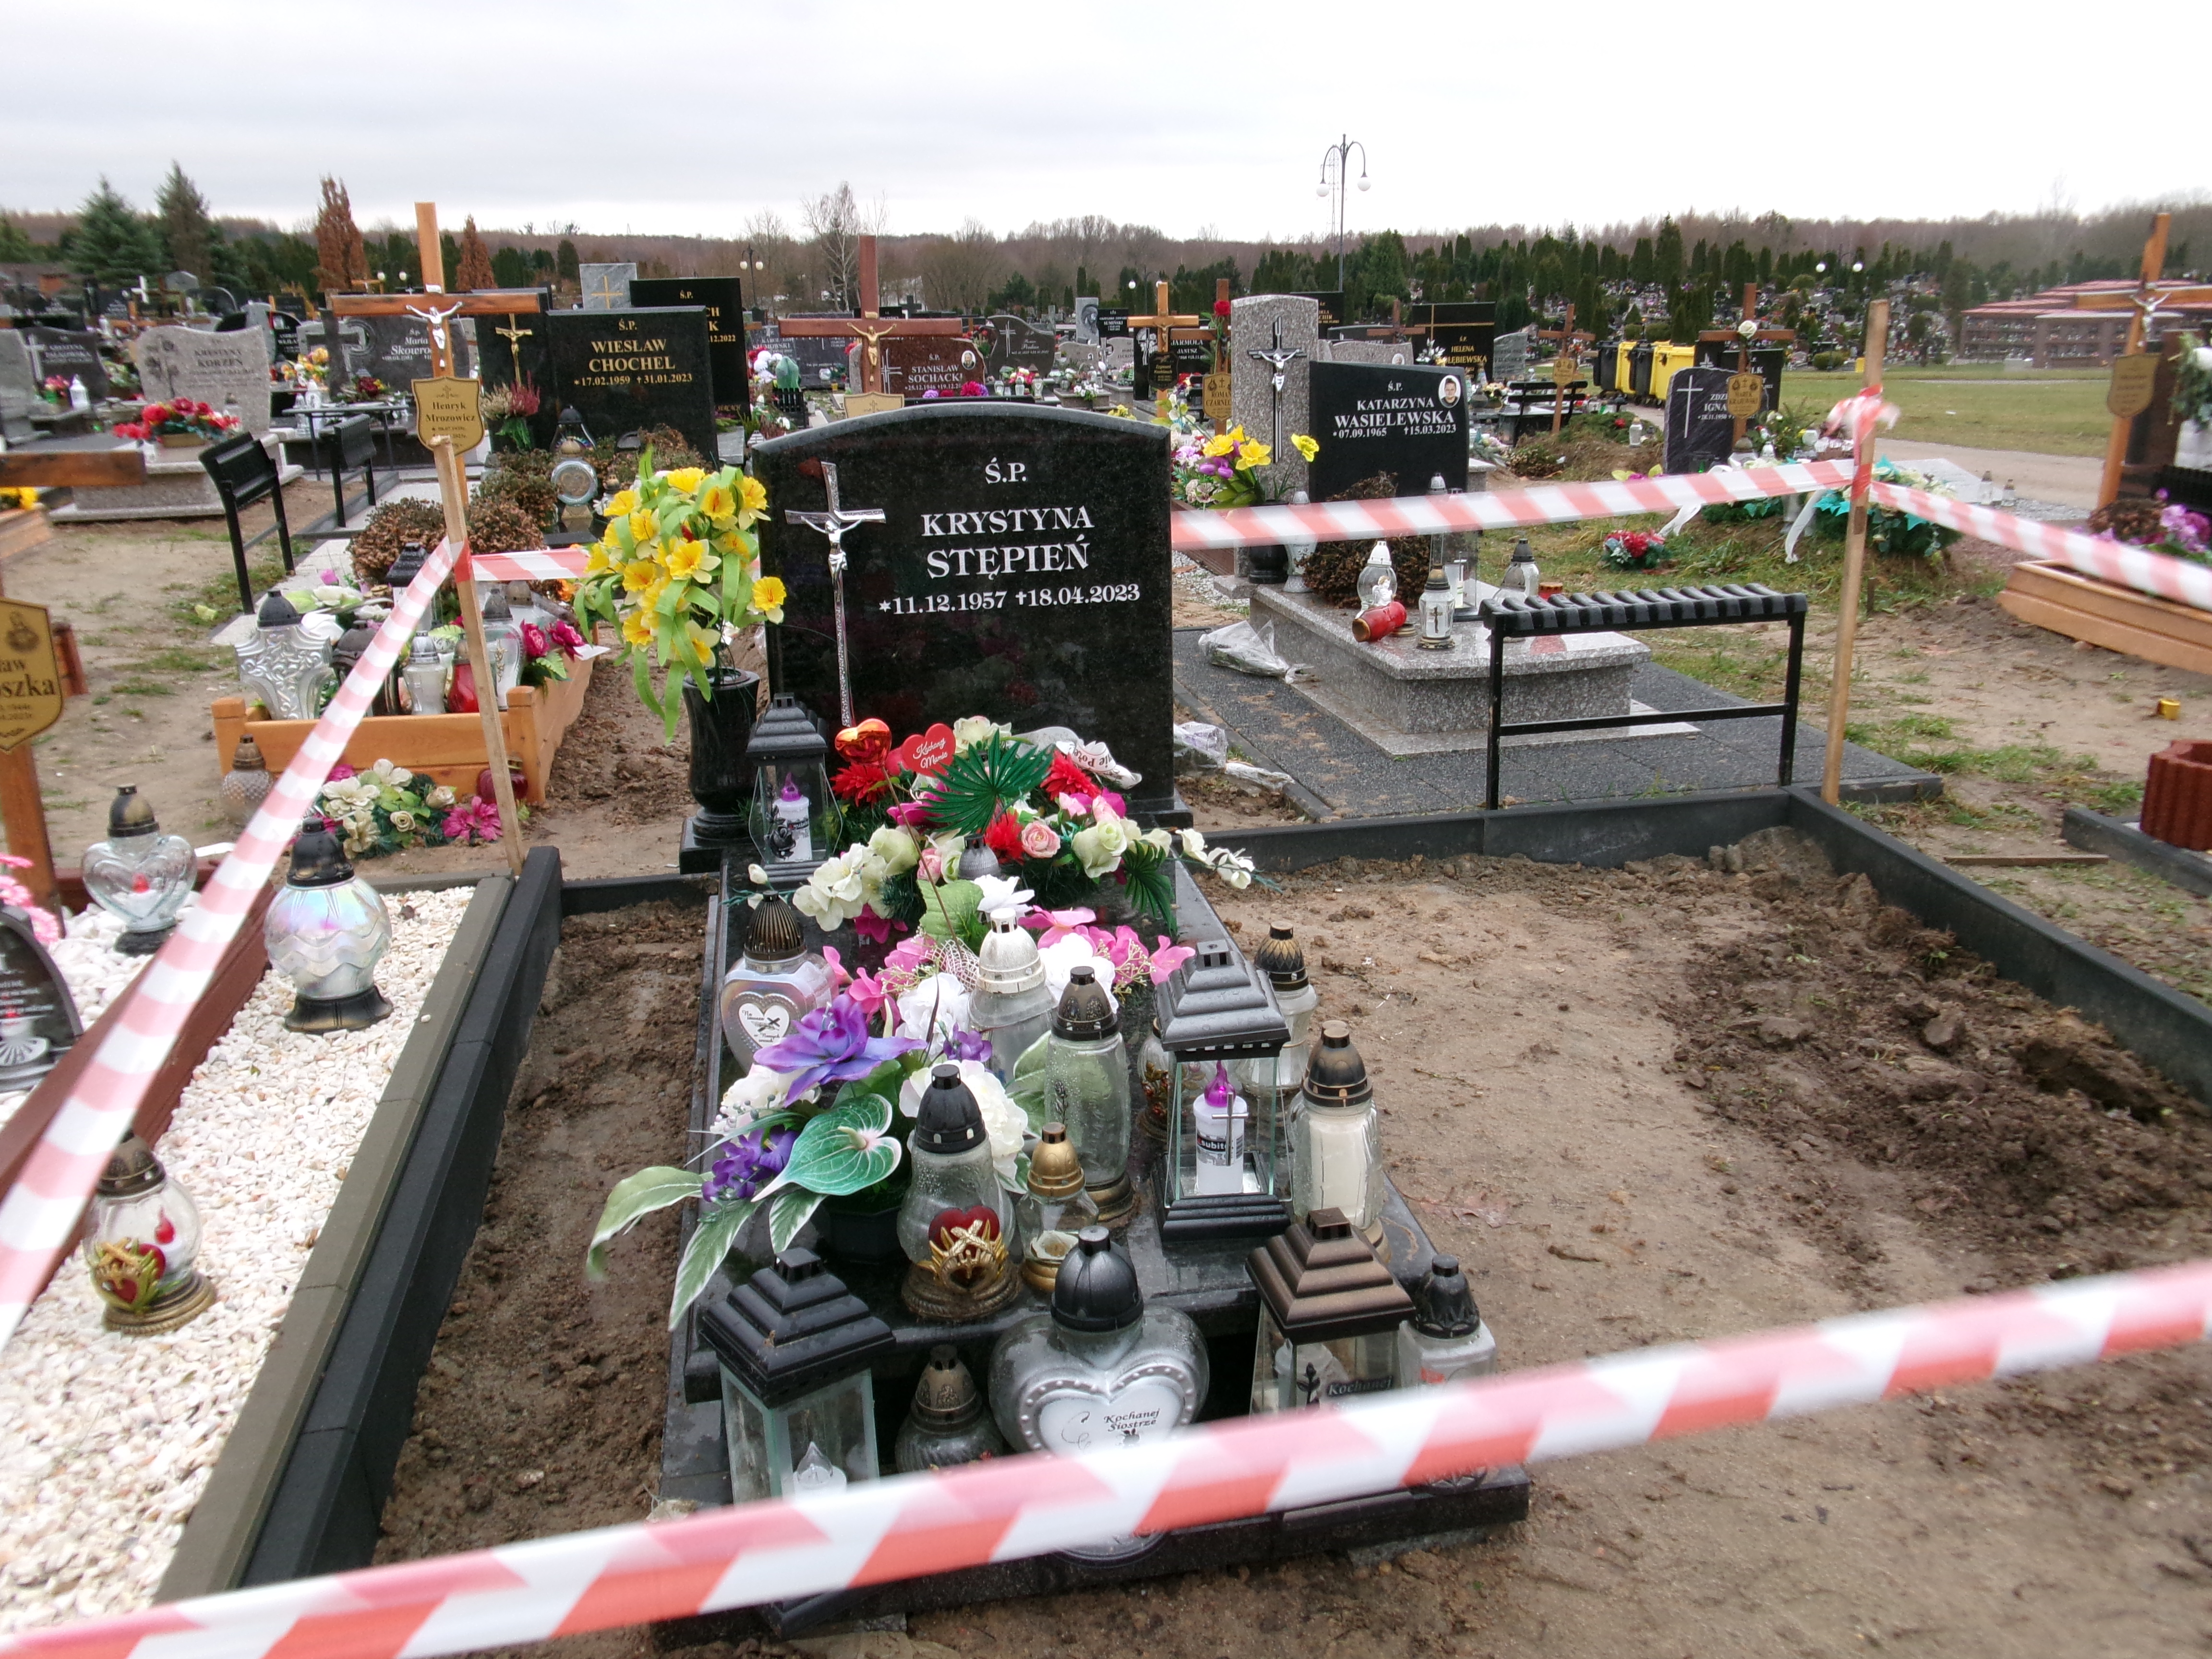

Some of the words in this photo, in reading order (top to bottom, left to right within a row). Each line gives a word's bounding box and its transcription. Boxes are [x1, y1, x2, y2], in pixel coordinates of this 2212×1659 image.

[618, 318, 637, 331] Ś.P.
[405, 337, 428, 345] Maria
[709, 335, 736, 343] .12.2022
[391, 345, 432, 356] Skowro
[589, 356, 675, 372] CHOCHEL
[1446, 355, 1488, 364] ŁĘBIEWSKA
[908, 373, 963, 383] SOCHACKI
[1388, 381, 1403, 391] Ś.P.
[433, 401, 466, 411] Henryk
[1357, 397, 1434, 411] KATARZYNA
[1704, 403, 1727, 411] IGNA
[425, 413, 475, 422] Mrozowicz
[1334, 410, 1455, 429] WASIELEWSKA
[985, 457, 1027, 484] Ś.P.
[921, 505, 1095, 536] KRYSTYNA
[927, 534, 1091, 580] STĘPIEŃ
[1201, 1140, 1226, 1150] subit
[1104, 1408, 1160, 1424] Kochanej
[1107, 1419, 1157, 1432] Siostrze
